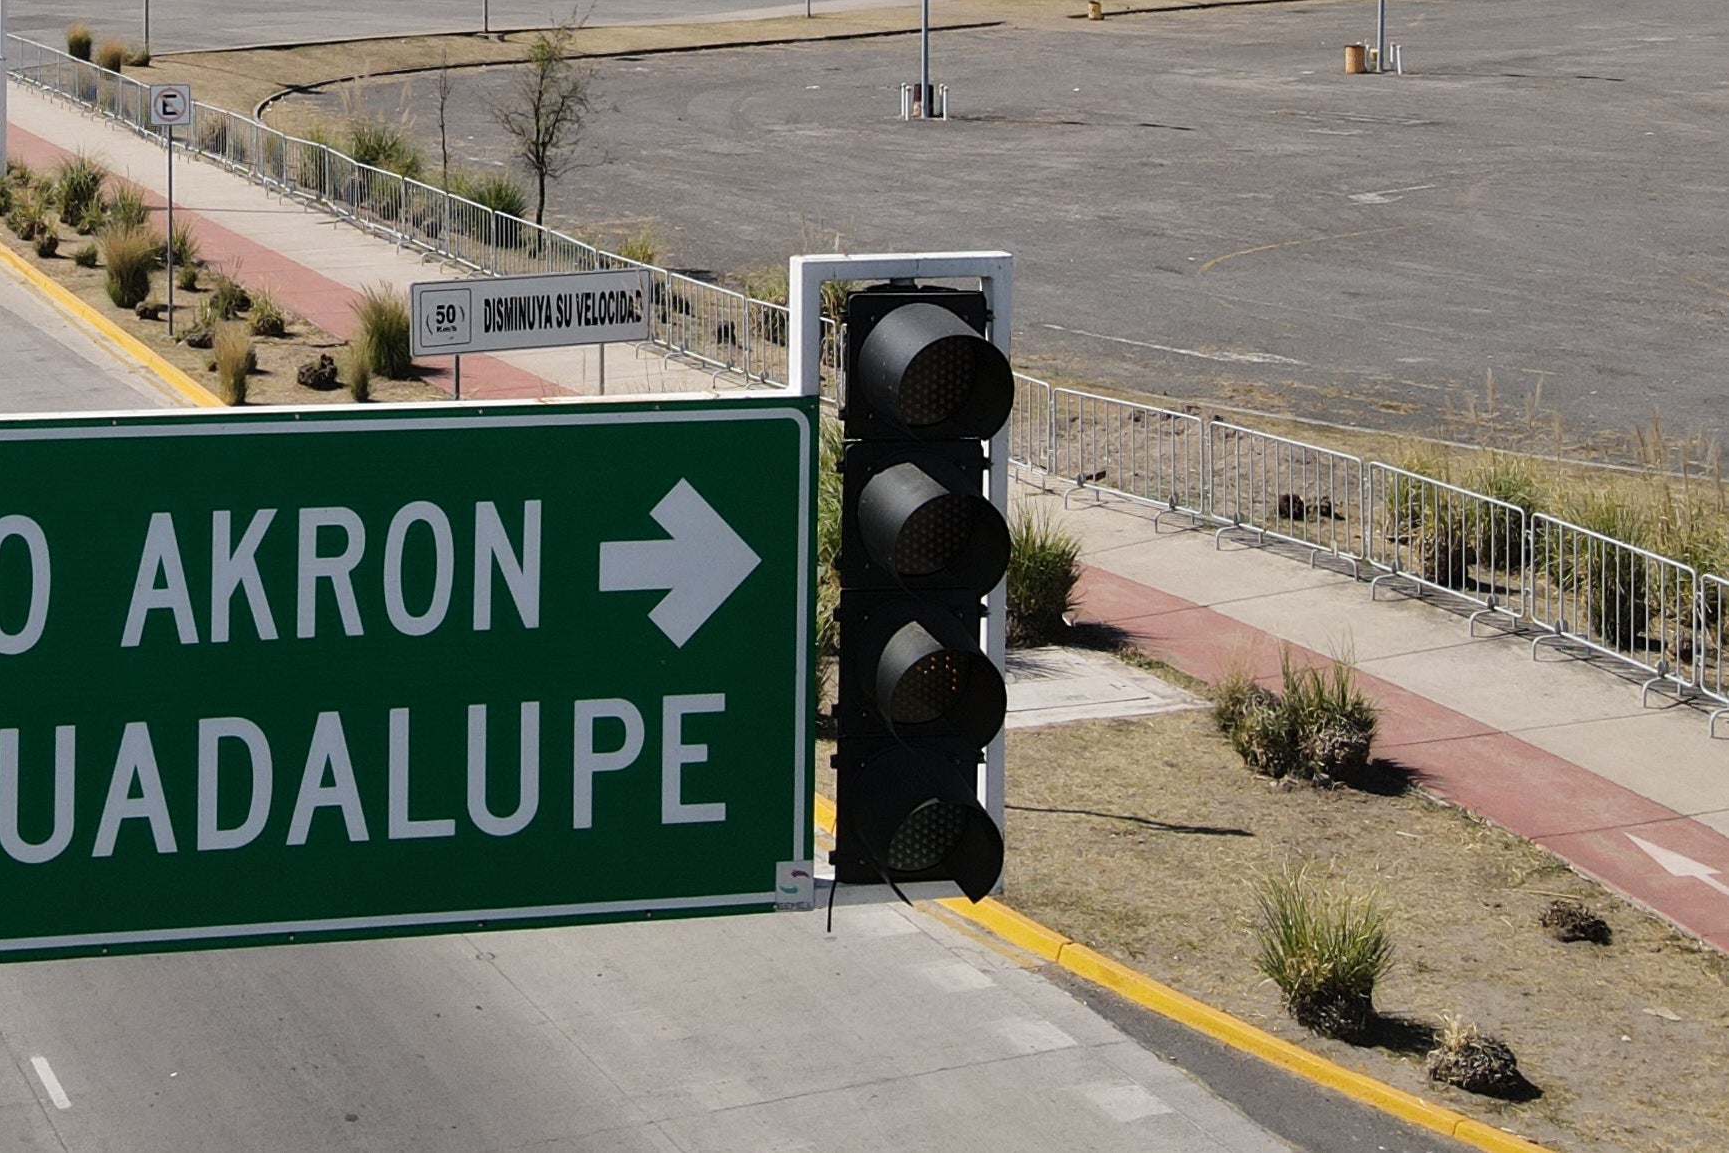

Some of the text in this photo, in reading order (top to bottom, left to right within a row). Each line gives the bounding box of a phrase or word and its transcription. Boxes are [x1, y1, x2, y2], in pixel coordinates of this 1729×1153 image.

[162, 94, 177, 115] E
[436, 304, 456, 324] 50
[484, 290, 644, 333] DISMINUYA SU VELOCIDAD
[121, 500, 542, 647] AKRON
